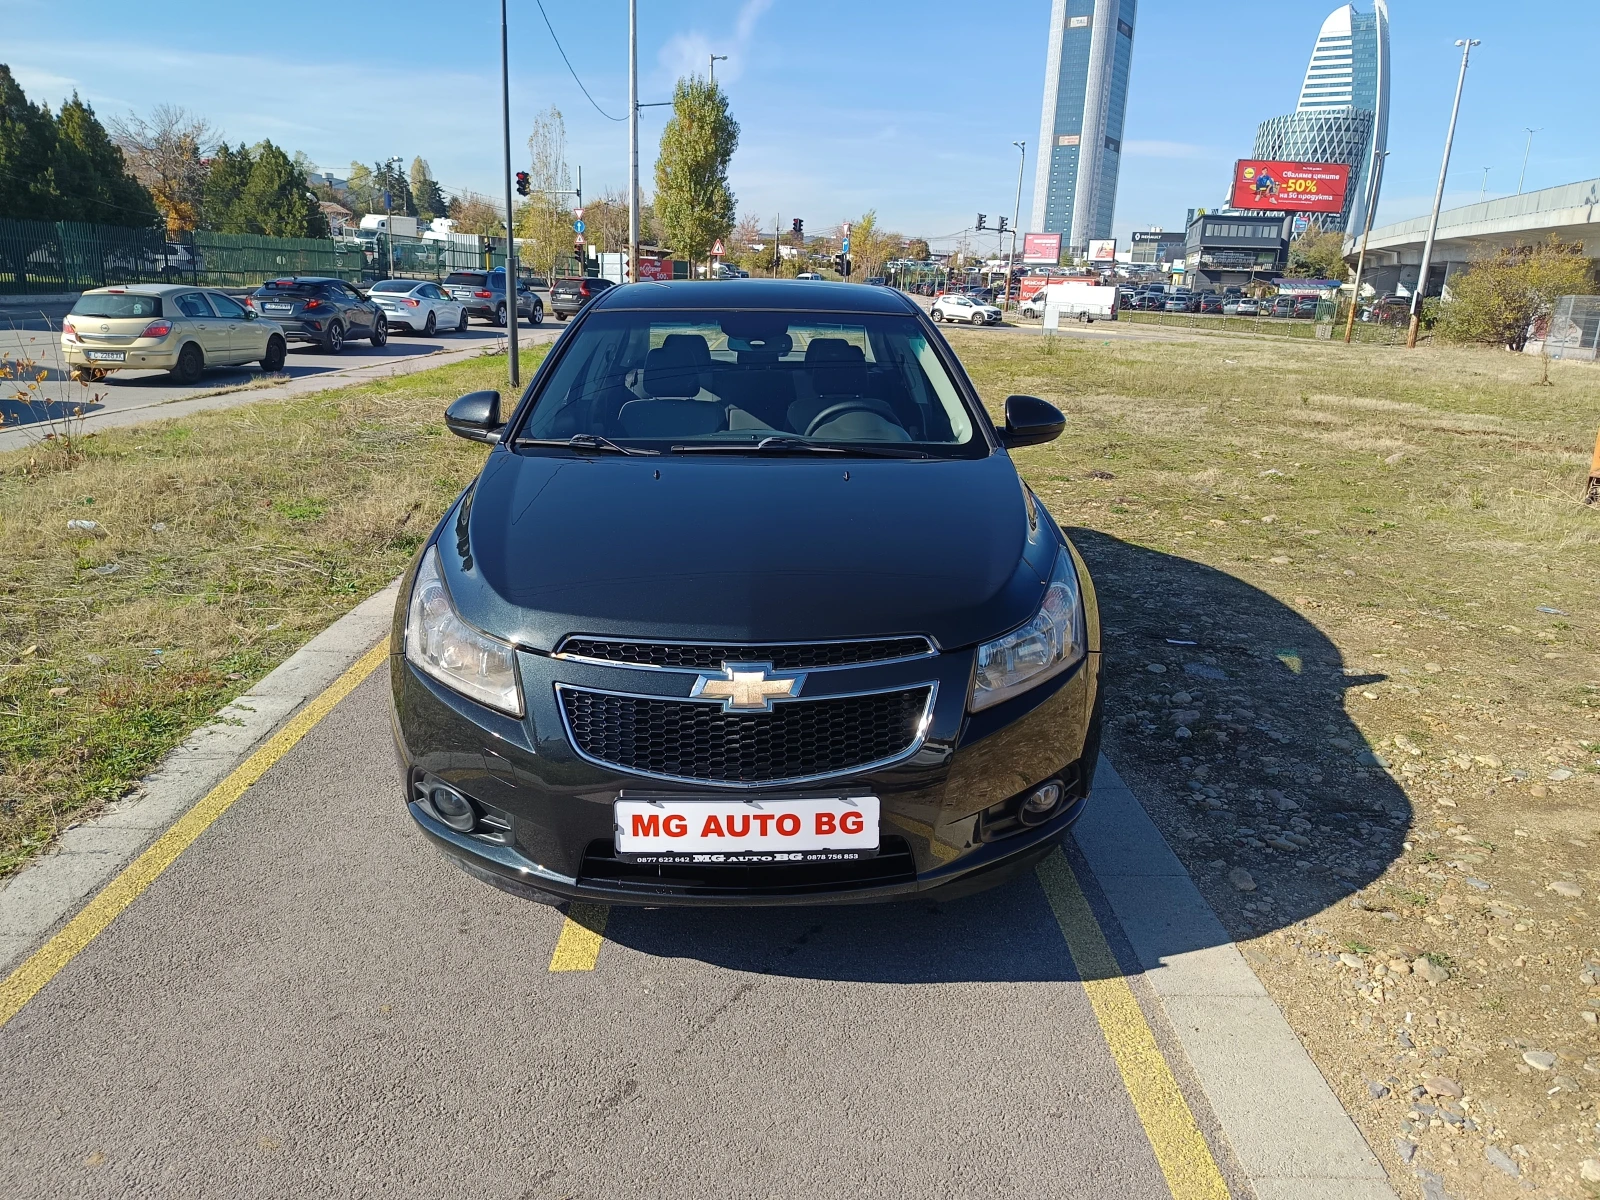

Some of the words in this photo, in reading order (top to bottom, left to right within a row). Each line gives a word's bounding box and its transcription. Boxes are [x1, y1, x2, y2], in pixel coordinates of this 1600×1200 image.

[1281, 179, 1317, 193] -50%
[1298, 193, 1333, 201] продукта
[632, 815, 687, 837] MG
[701, 814, 801, 837] AUTO
[815, 812, 863, 835] BG
[693, 854, 726, 862] MG
[774, 853, 804, 861] BG
